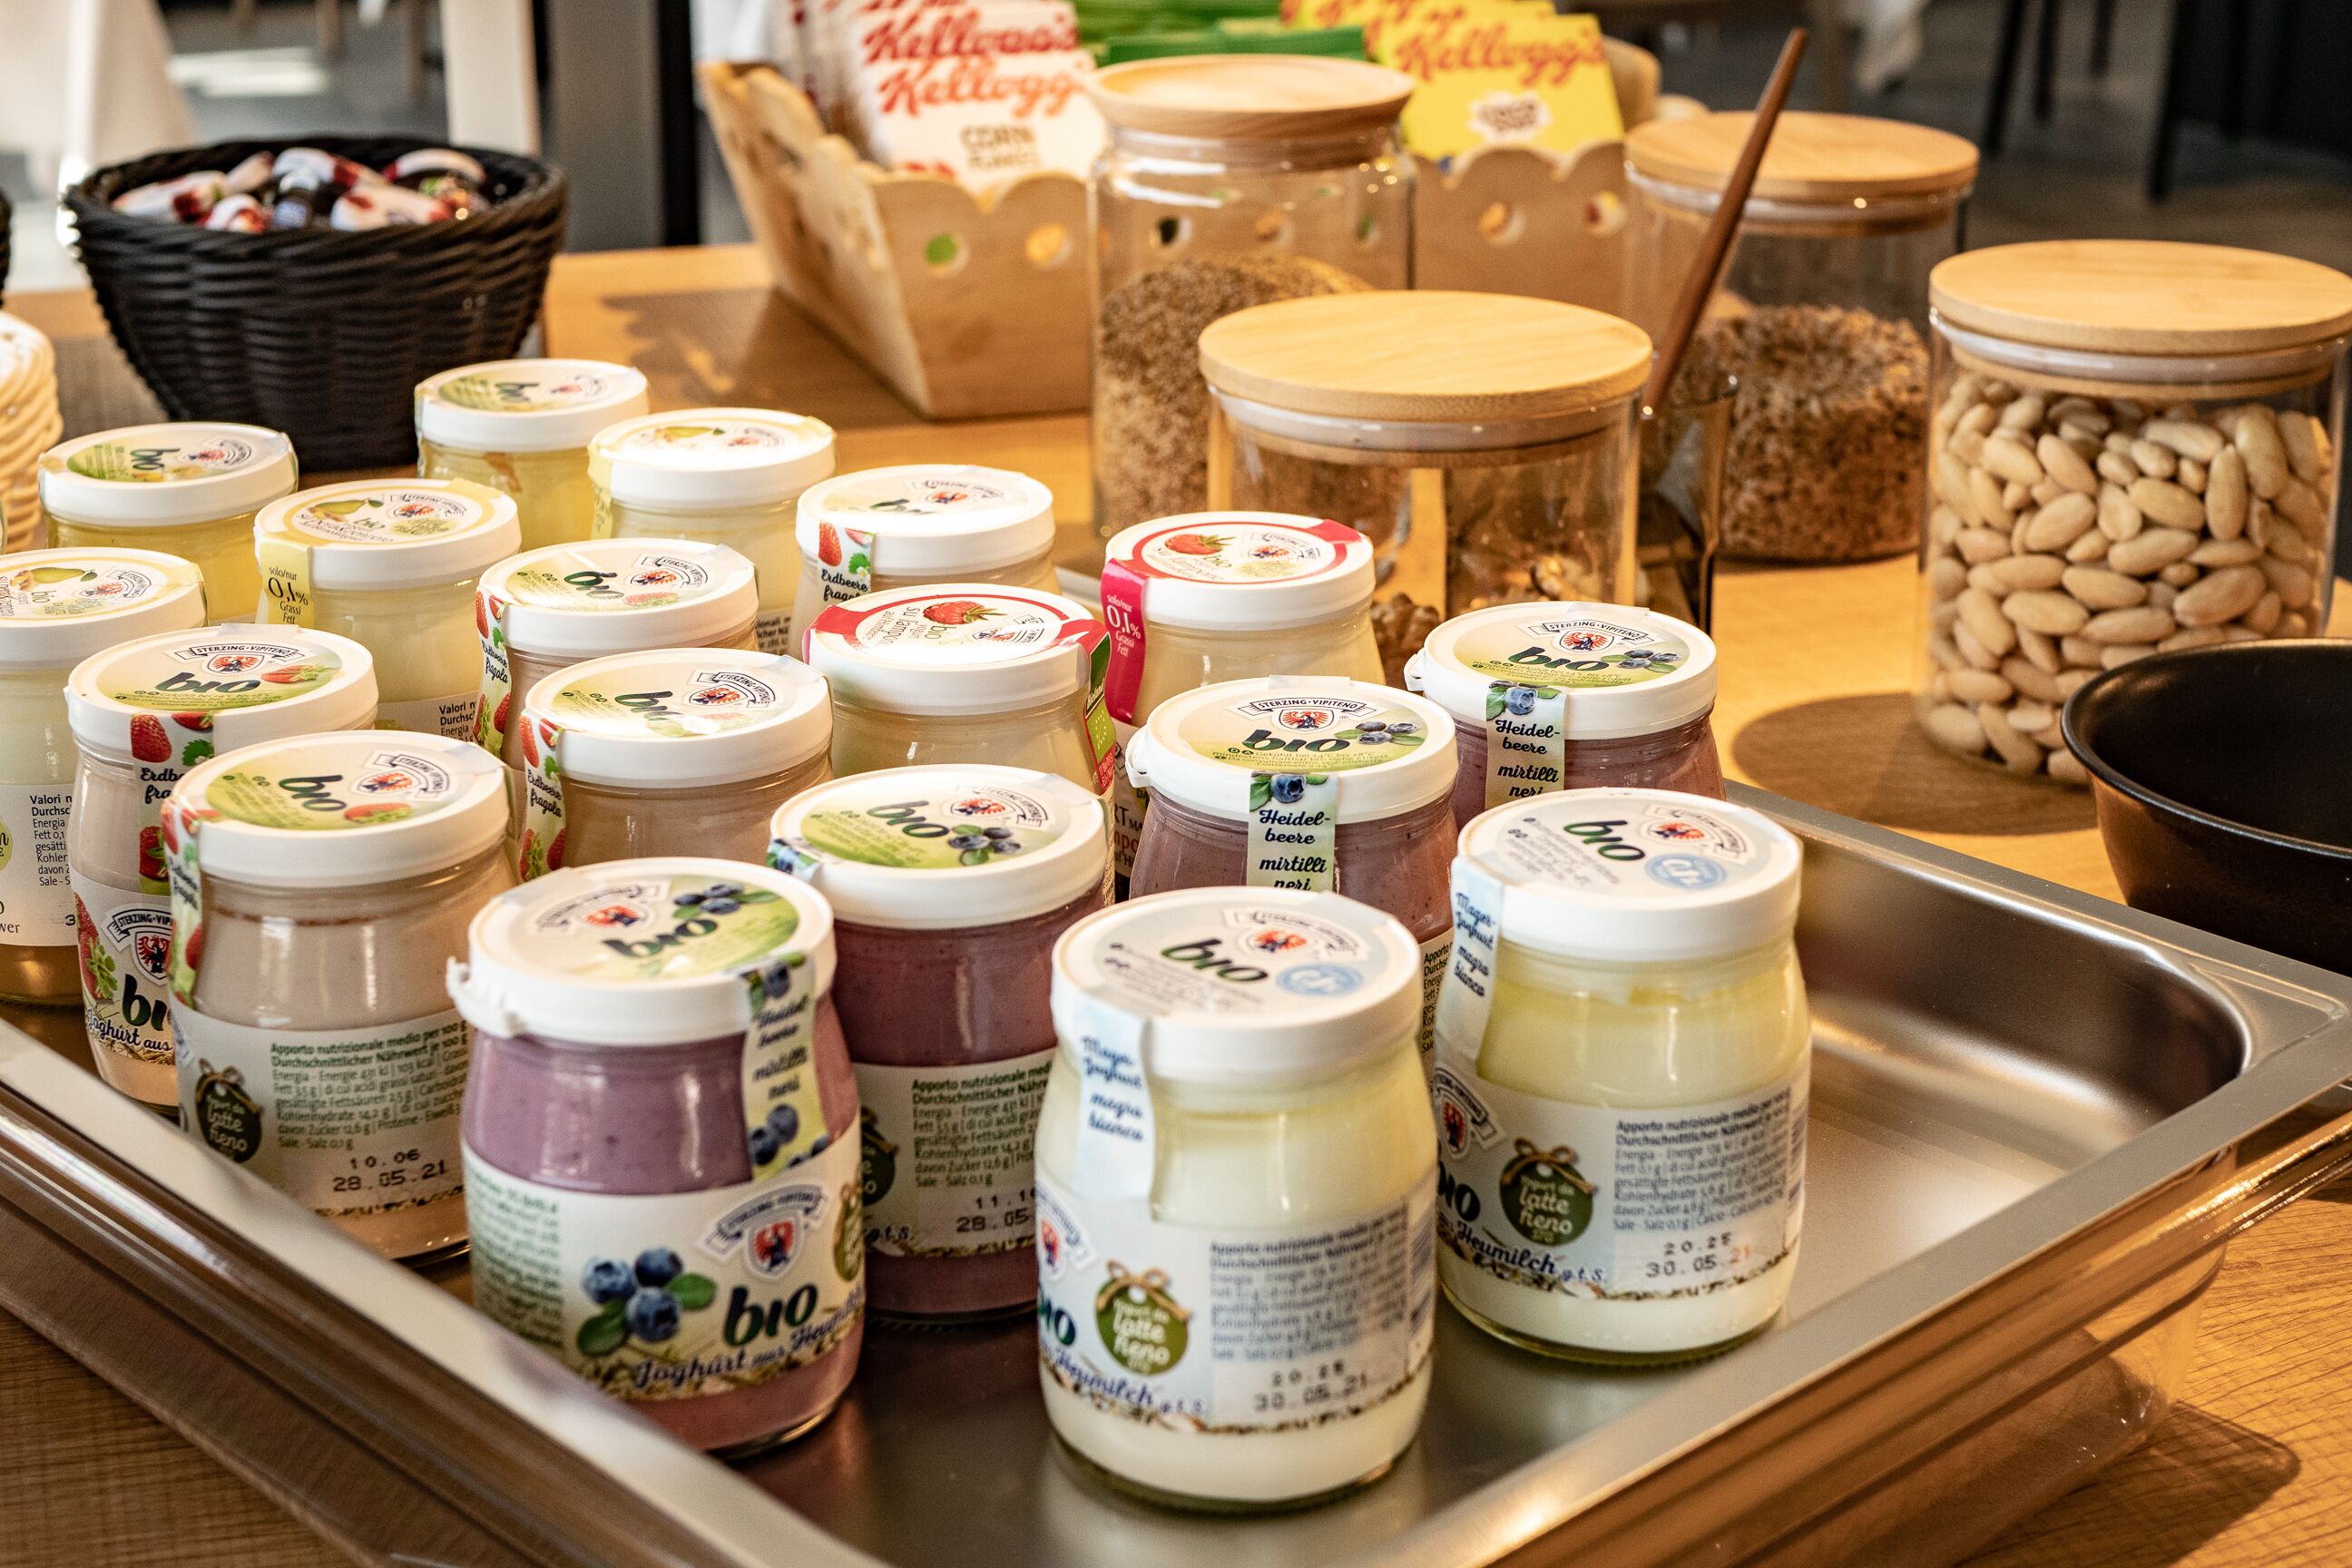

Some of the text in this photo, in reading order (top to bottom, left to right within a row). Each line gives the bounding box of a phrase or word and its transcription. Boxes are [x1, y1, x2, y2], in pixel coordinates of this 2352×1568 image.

[1396, 23, 1606, 86] Kellogg's
[878, 54, 1094, 118] Kellogg'
[269, 565, 298, 582] solo/nur
[820, 568, 868, 593] Erdbeere
[1549, 621, 1641, 639] STERZING VIPITENO
[196, 643, 291, 656] STERZING VIPITENO
[1507, 646, 1611, 671] bio
[155, 671, 261, 693] bio
[720, 672, 754, 689] STERZING
[439, 704, 466, 715] Valori
[1259, 698, 1358, 711] STERZING VIPITENO
[440, 711, 475, 725] Durchsc
[441, 726, 469, 737] Energia
[1494, 719, 1561, 740] Heidel-
[1241, 729, 1351, 752] bio
[1502, 738, 1548, 755] beere
[1497, 764, 1559, 784] mirtilli
[30, 795, 61, 805] Valori
[144, 784, 172, 804] fra
[279, 774, 348, 812] bio
[1509, 785, 1544, 798] neri
[32, 807, 71, 817] Durchsc
[530, 789, 563, 818] fragola
[33, 818, 65, 829] Energia
[866, 799, 950, 838] bio
[1259, 808, 1332, 827] Heidel-
[34, 830, 65, 840] Fett 0,1
[1264, 827, 1316, 844] beere
[1563, 818, 1645, 861] bio
[35, 842, 66, 854] gesätti
[38, 866, 64, 875] davon
[1259, 856, 1328, 875] mirtilli
[39, 876, 58, 886] Sale
[1273, 878, 1312, 891] neri
[118, 913, 152, 927] STERZING
[603, 918, 720, 958] bio
[1161, 937, 1269, 983] bio
[1424, 946, 1449, 965] Apporto
[1424, 972, 1445, 990] Energi
[122, 974, 169, 1032] bi
[143, 1037, 173, 1052] aus
[271, 1043, 315, 1056] Apporto
[317, 1039, 384, 1054] nutrizionale
[387, 1032, 421, 1045] medio
[423, 1028, 440, 1042] per
[271, 1054, 374, 1068] Durchschnittlicher
[375, 1044, 428, 1061] Nährwert
[273, 1070, 309, 1083] Energia
[318, 1069, 358, 1083] Energie
[912, 1060, 1053, 1093] Apporto nutrizionale med
[913, 1078, 1048, 1105] Durchschnittlicher Nähr
[1616, 1119, 1663, 1132] Apporto
[1456, 1220, 1557, 1276] Heumilch
[725, 1283, 818, 1348] bio
[633, 1349, 747, 1389] Joghurt
